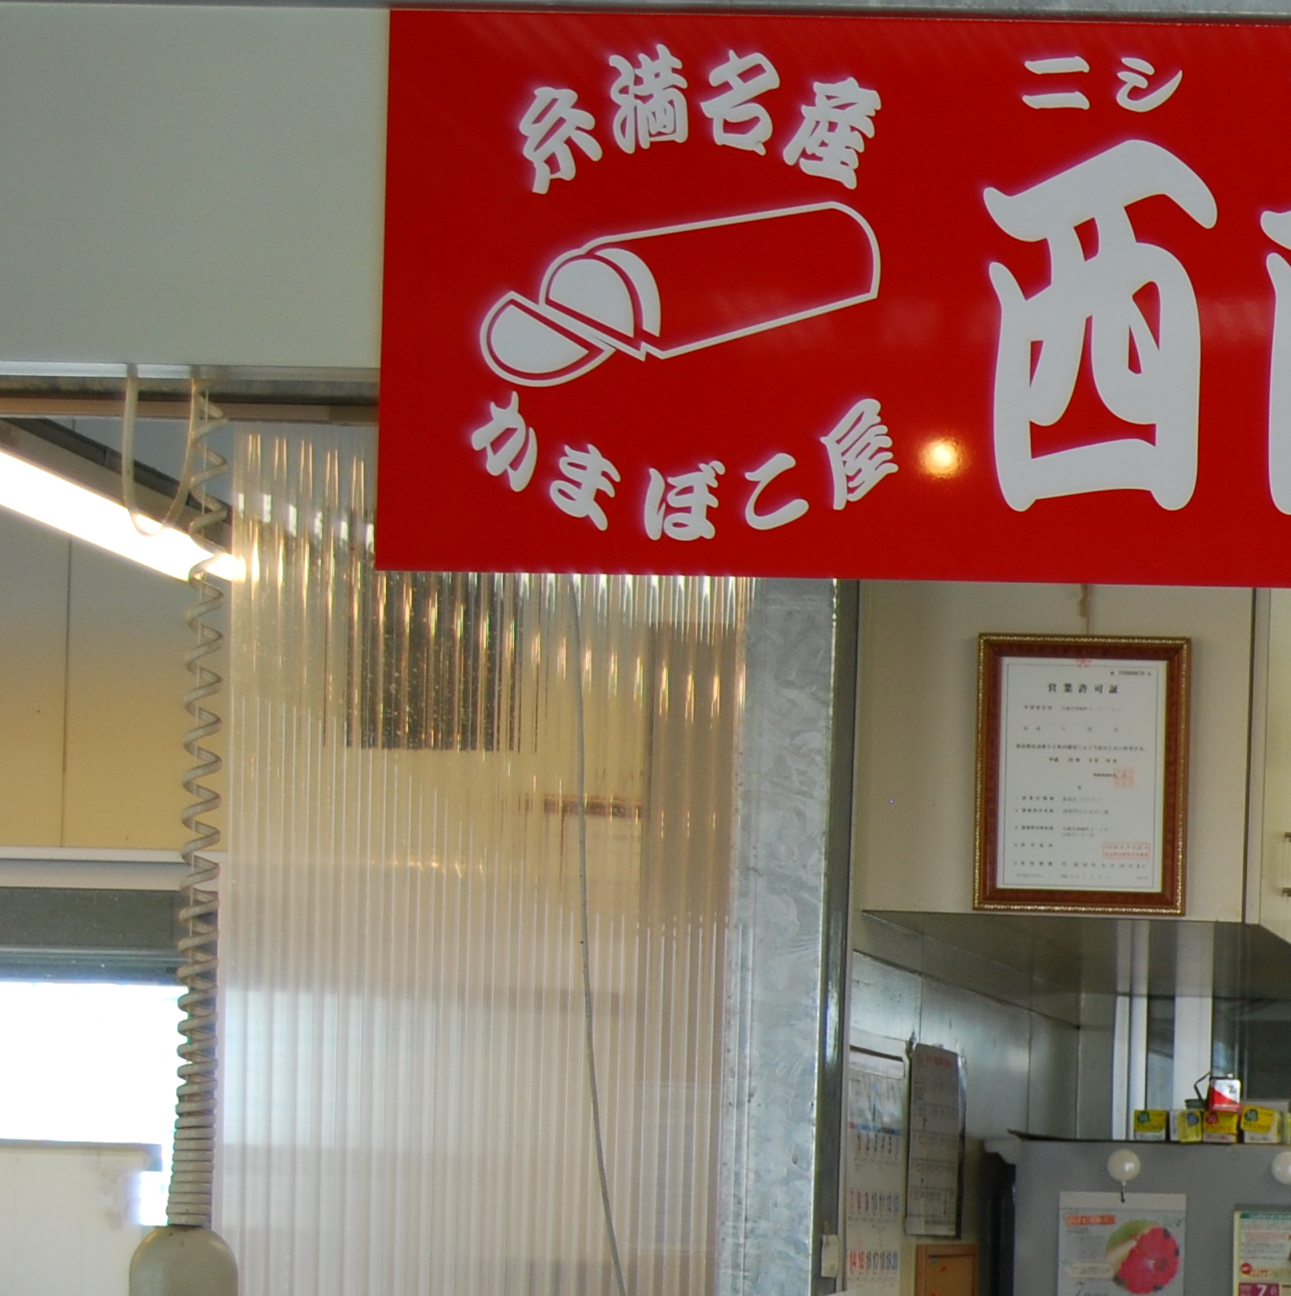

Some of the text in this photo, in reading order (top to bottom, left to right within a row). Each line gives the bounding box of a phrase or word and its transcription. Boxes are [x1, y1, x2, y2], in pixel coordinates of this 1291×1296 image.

[519, 44, 881, 193] 糸満名産
[1023, 55, 1183, 112] ニシ
[471, 391, 898, 541] かまぼこ屋
